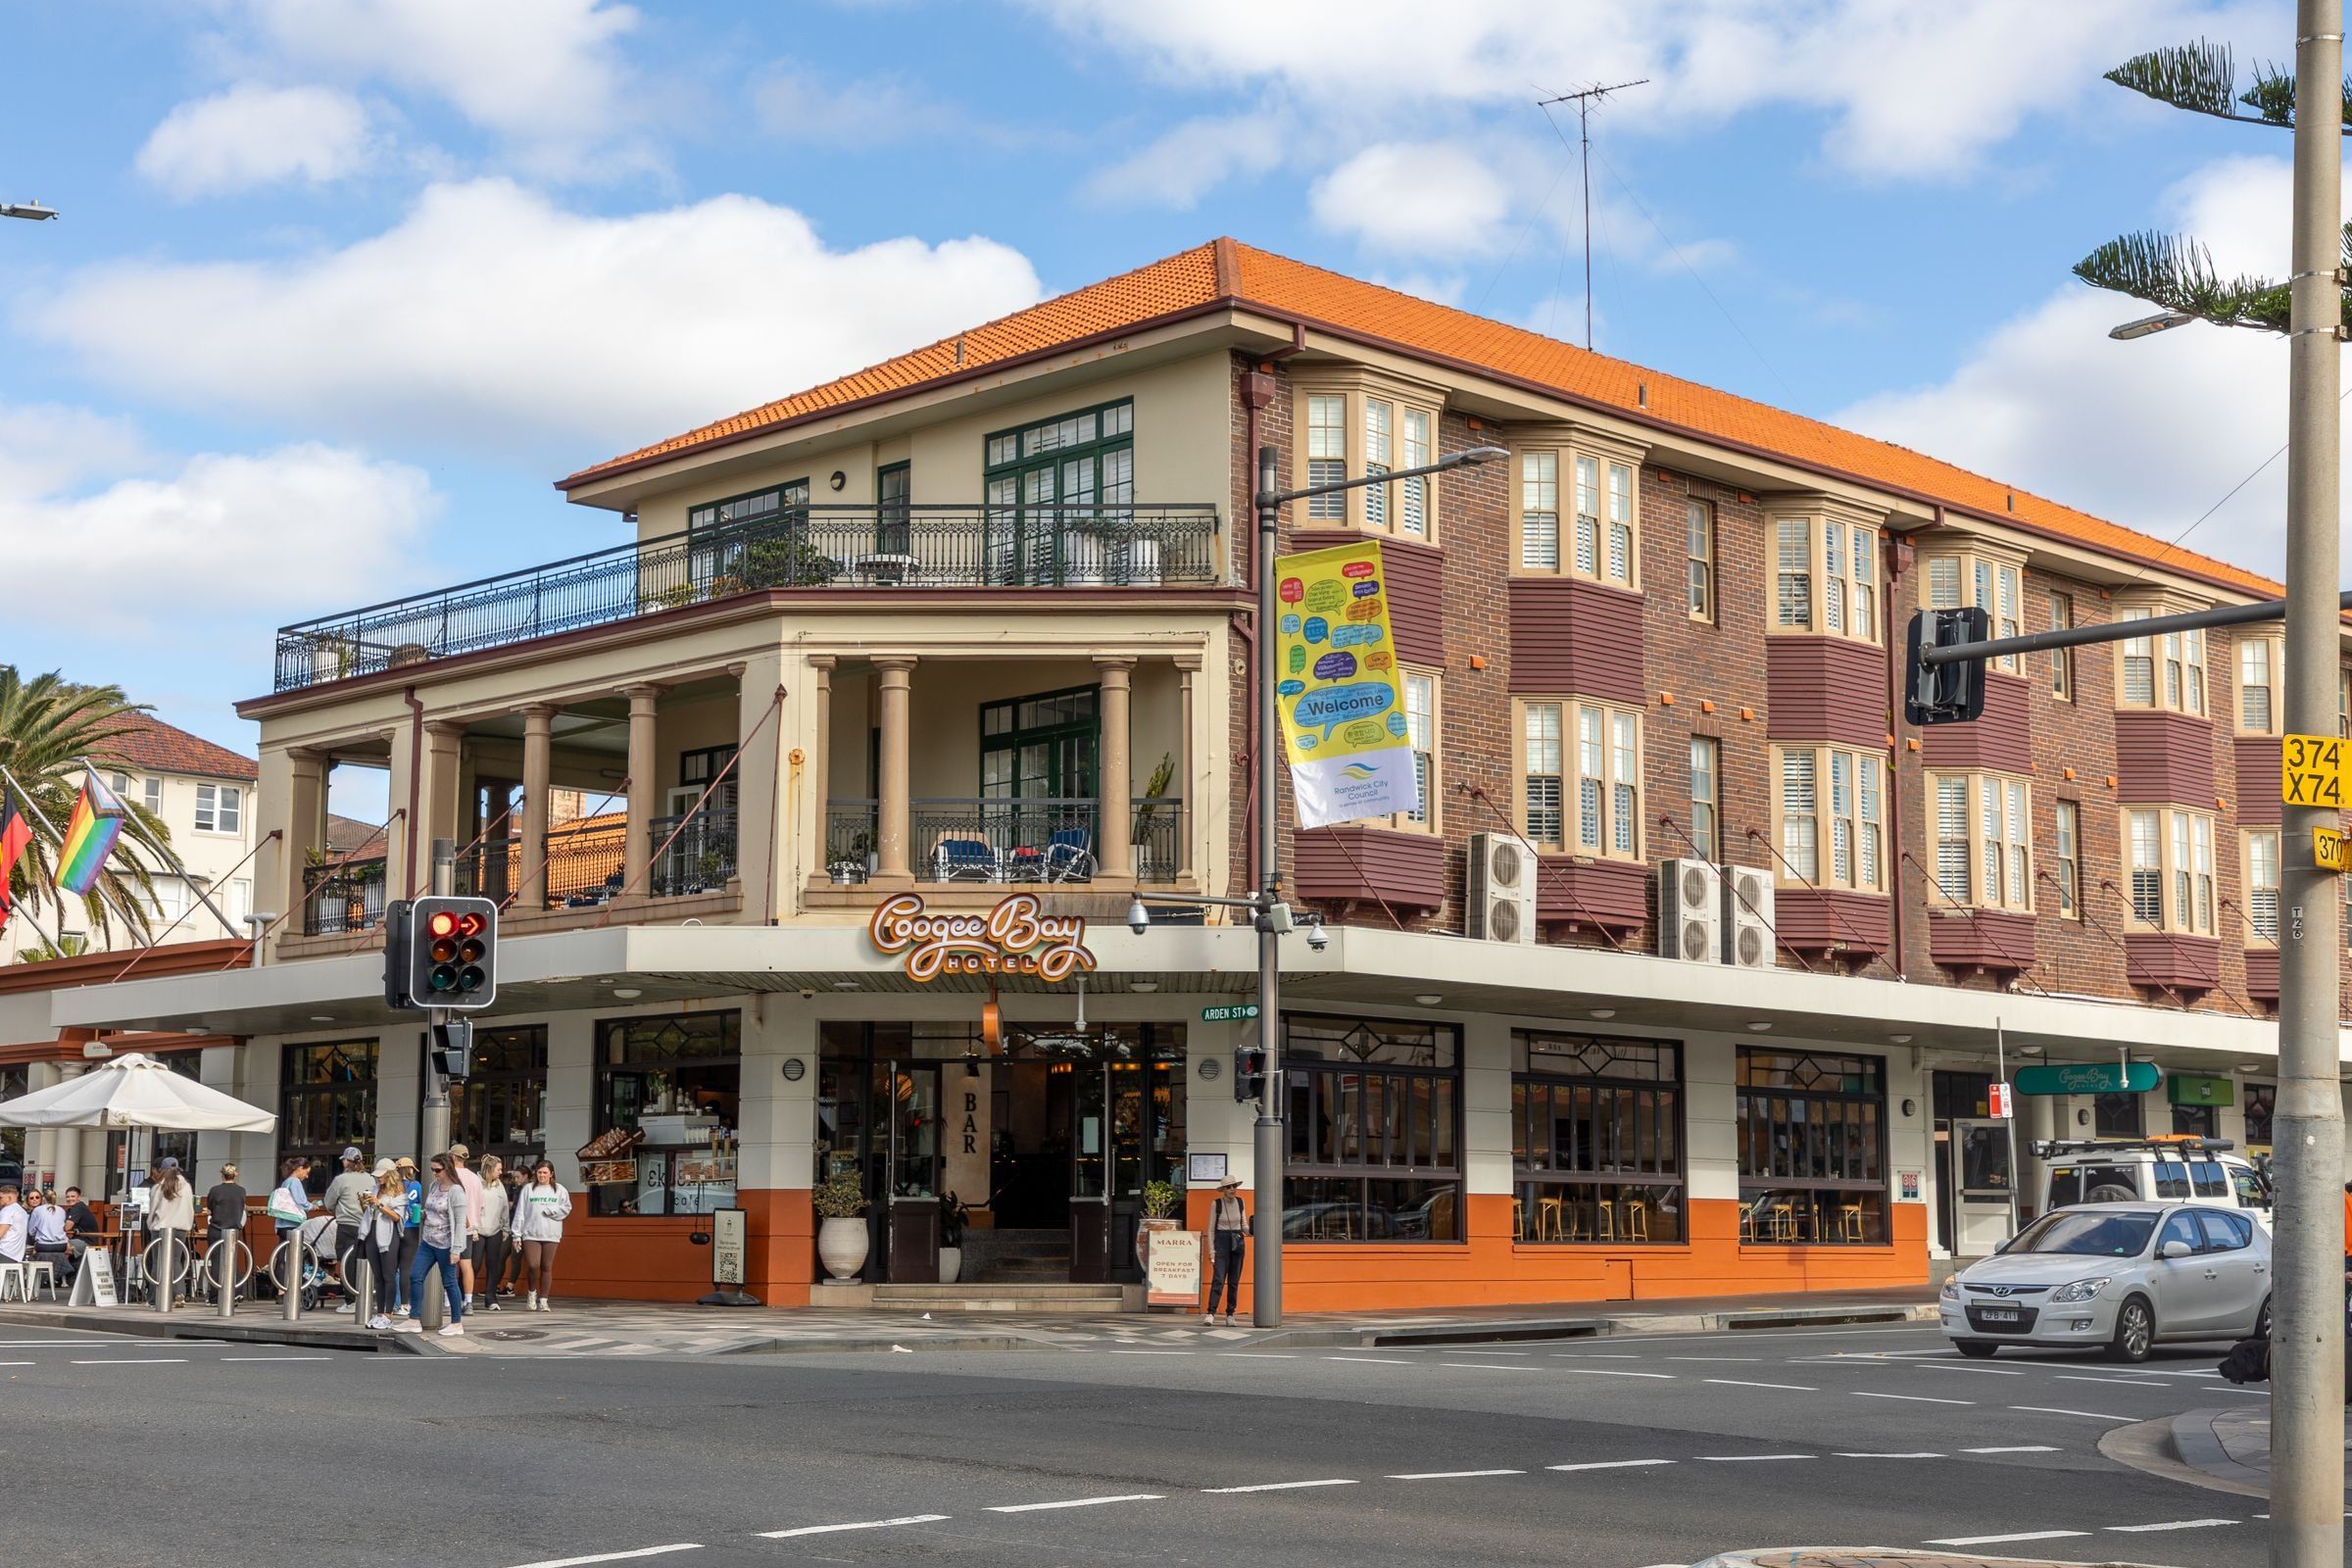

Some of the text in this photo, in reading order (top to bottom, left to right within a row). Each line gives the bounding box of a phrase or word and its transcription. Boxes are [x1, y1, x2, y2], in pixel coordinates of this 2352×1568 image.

[1307, 695, 1384, 715] Welcome
[2288, 738, 2340, 770] 374
[1334, 780, 1388, 794] Randwick City
[1348, 789, 1378, 800] Council
[2288, 772, 2340, 805] X74
[2319, 835, 2343, 863] 370
[874, 896, 1093, 977] Coogee Bay
[948, 957, 1034, 968] HOTEL
[1205, 1007, 1242, 1019] ARDEN ST
[2059, 1067, 2112, 1090] Coogee Bay
[2201, 1087, 2211, 1096] TAB
[962, 1093, 978, 1153] BAR
